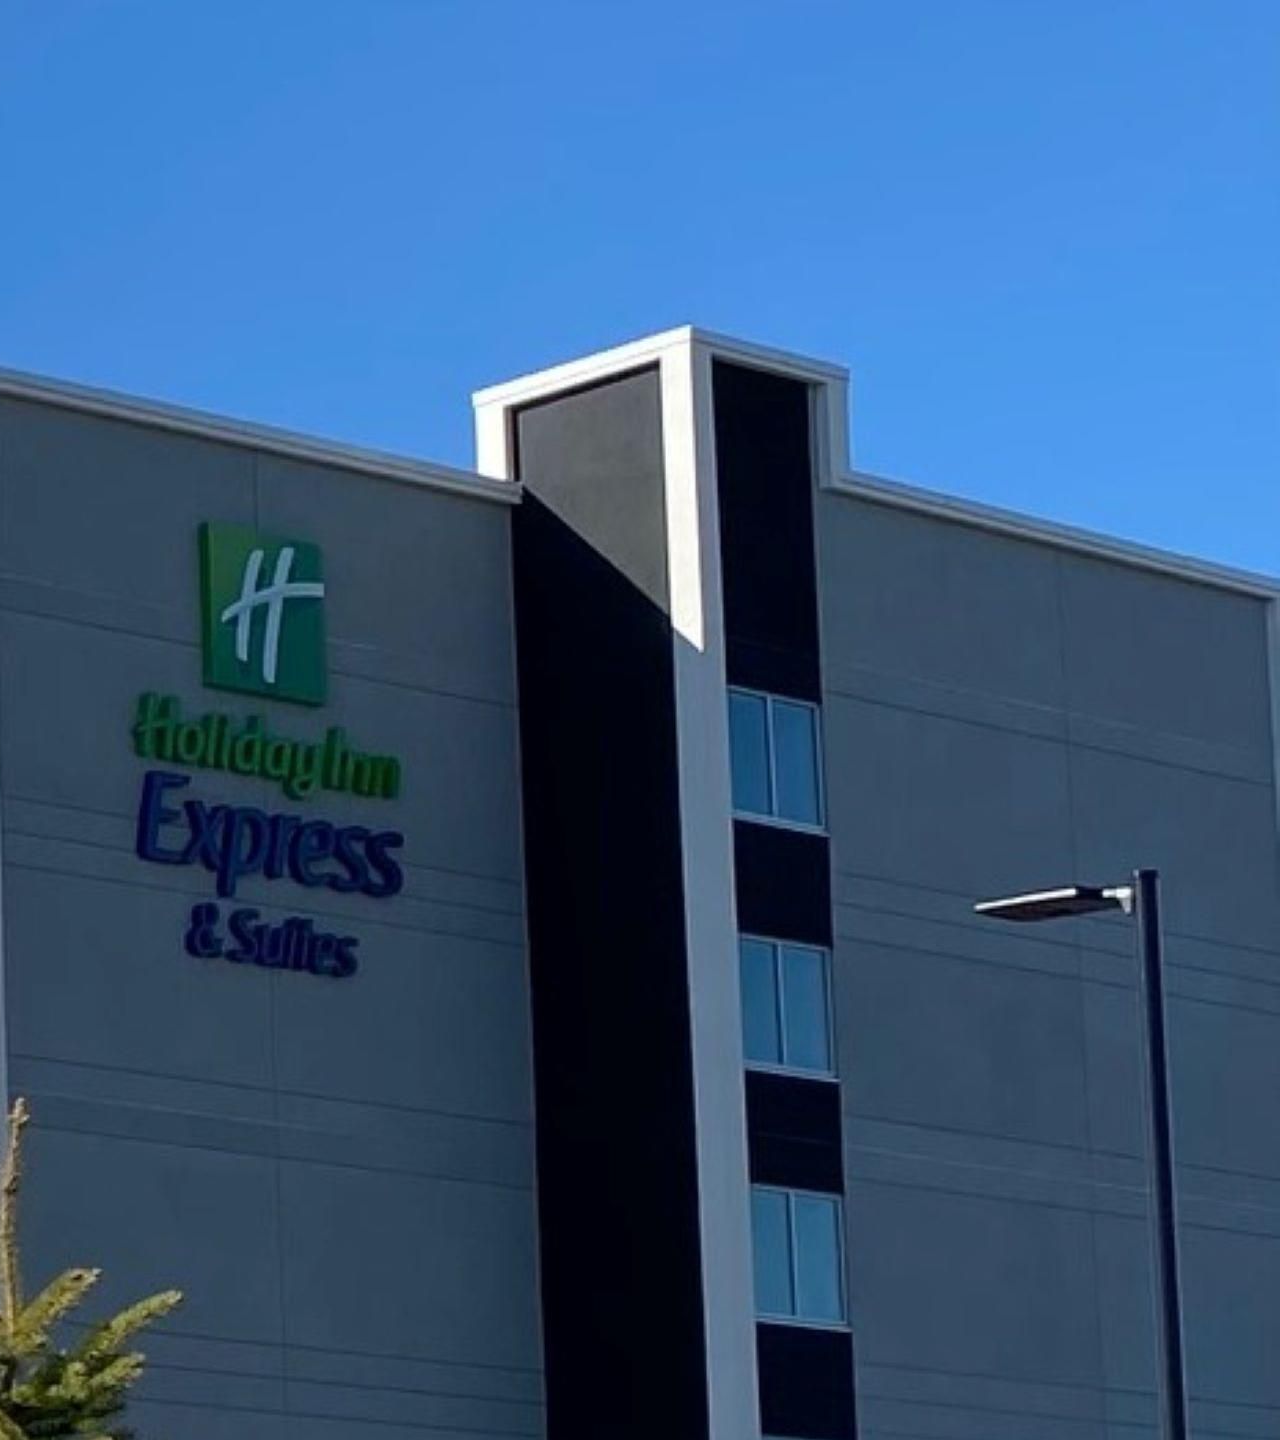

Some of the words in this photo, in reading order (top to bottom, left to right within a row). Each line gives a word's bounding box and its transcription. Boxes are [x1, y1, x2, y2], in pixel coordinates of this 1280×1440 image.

[220, 546, 324, 684] H
[132, 692, 321, 800] Holiday
[320, 727, 401, 798] Inn
[136, 770, 404, 898] Express
[184, 902, 224, 958] &
[226, 908, 358, 978] Suites
